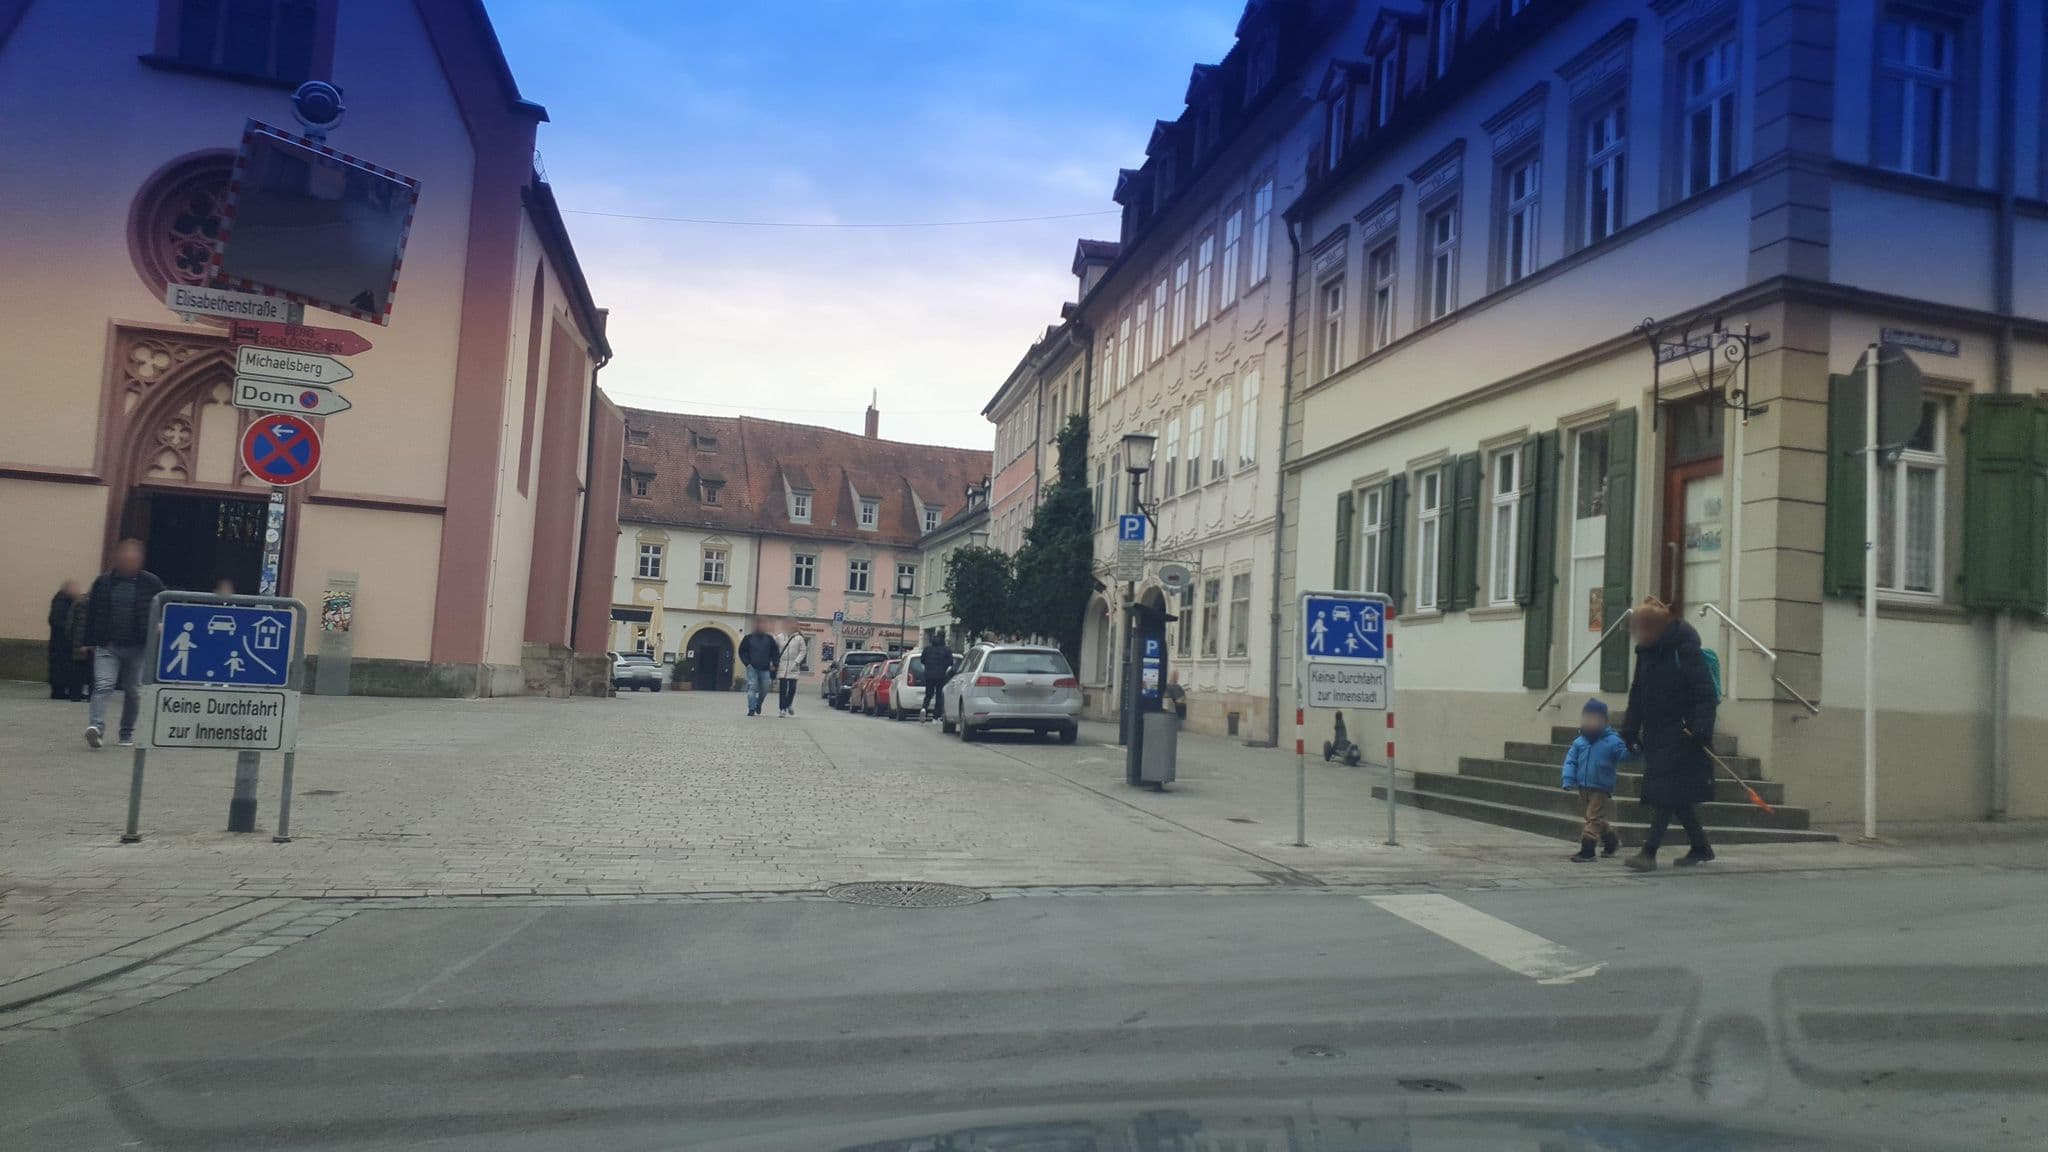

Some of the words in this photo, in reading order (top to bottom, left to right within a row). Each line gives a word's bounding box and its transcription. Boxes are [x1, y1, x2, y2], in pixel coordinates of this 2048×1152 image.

[176, 289, 277, 318] Elisabethenstraße
[246, 354, 322, 377] Michaelsberg
[242, 385, 294, 406] Dom
[1125, 518, 1140, 539] P
[1145, 639, 1158, 656] P
[1312, 671, 1336, 683] Keine
[1338, 671, 1382, 685] Durchfahrt
[1317, 690, 1331, 702] zur
[1333, 690, 1377, 703] Innenstadt
[162, 697, 201, 714] Keine
[207, 698, 278, 717] Durchfahrt
[168, 725, 190, 739] zur
[195, 723, 268, 742] Innenstadt
